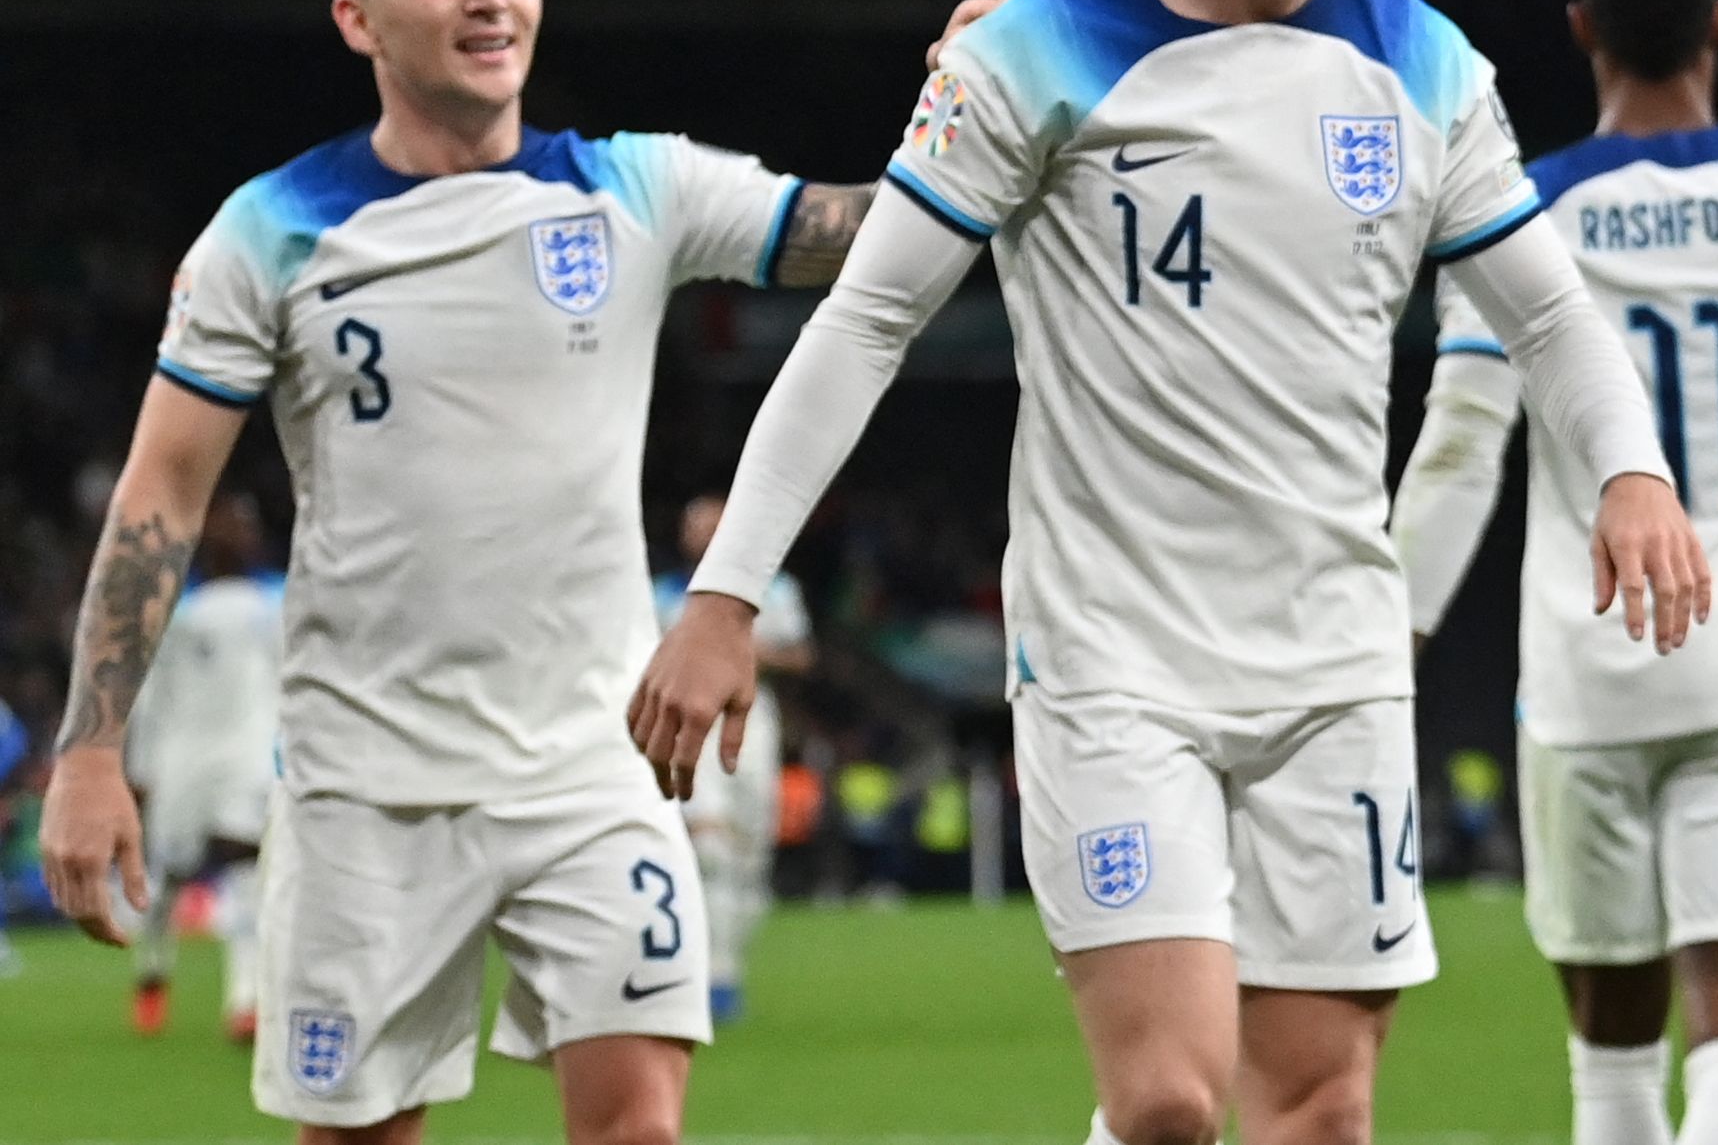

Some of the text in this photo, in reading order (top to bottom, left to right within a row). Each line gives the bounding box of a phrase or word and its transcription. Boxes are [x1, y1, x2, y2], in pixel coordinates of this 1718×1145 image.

[1111, 191, 1212, 308] 14
[336, 318, 391, 422] 3
[632, 860, 681, 960] 3
